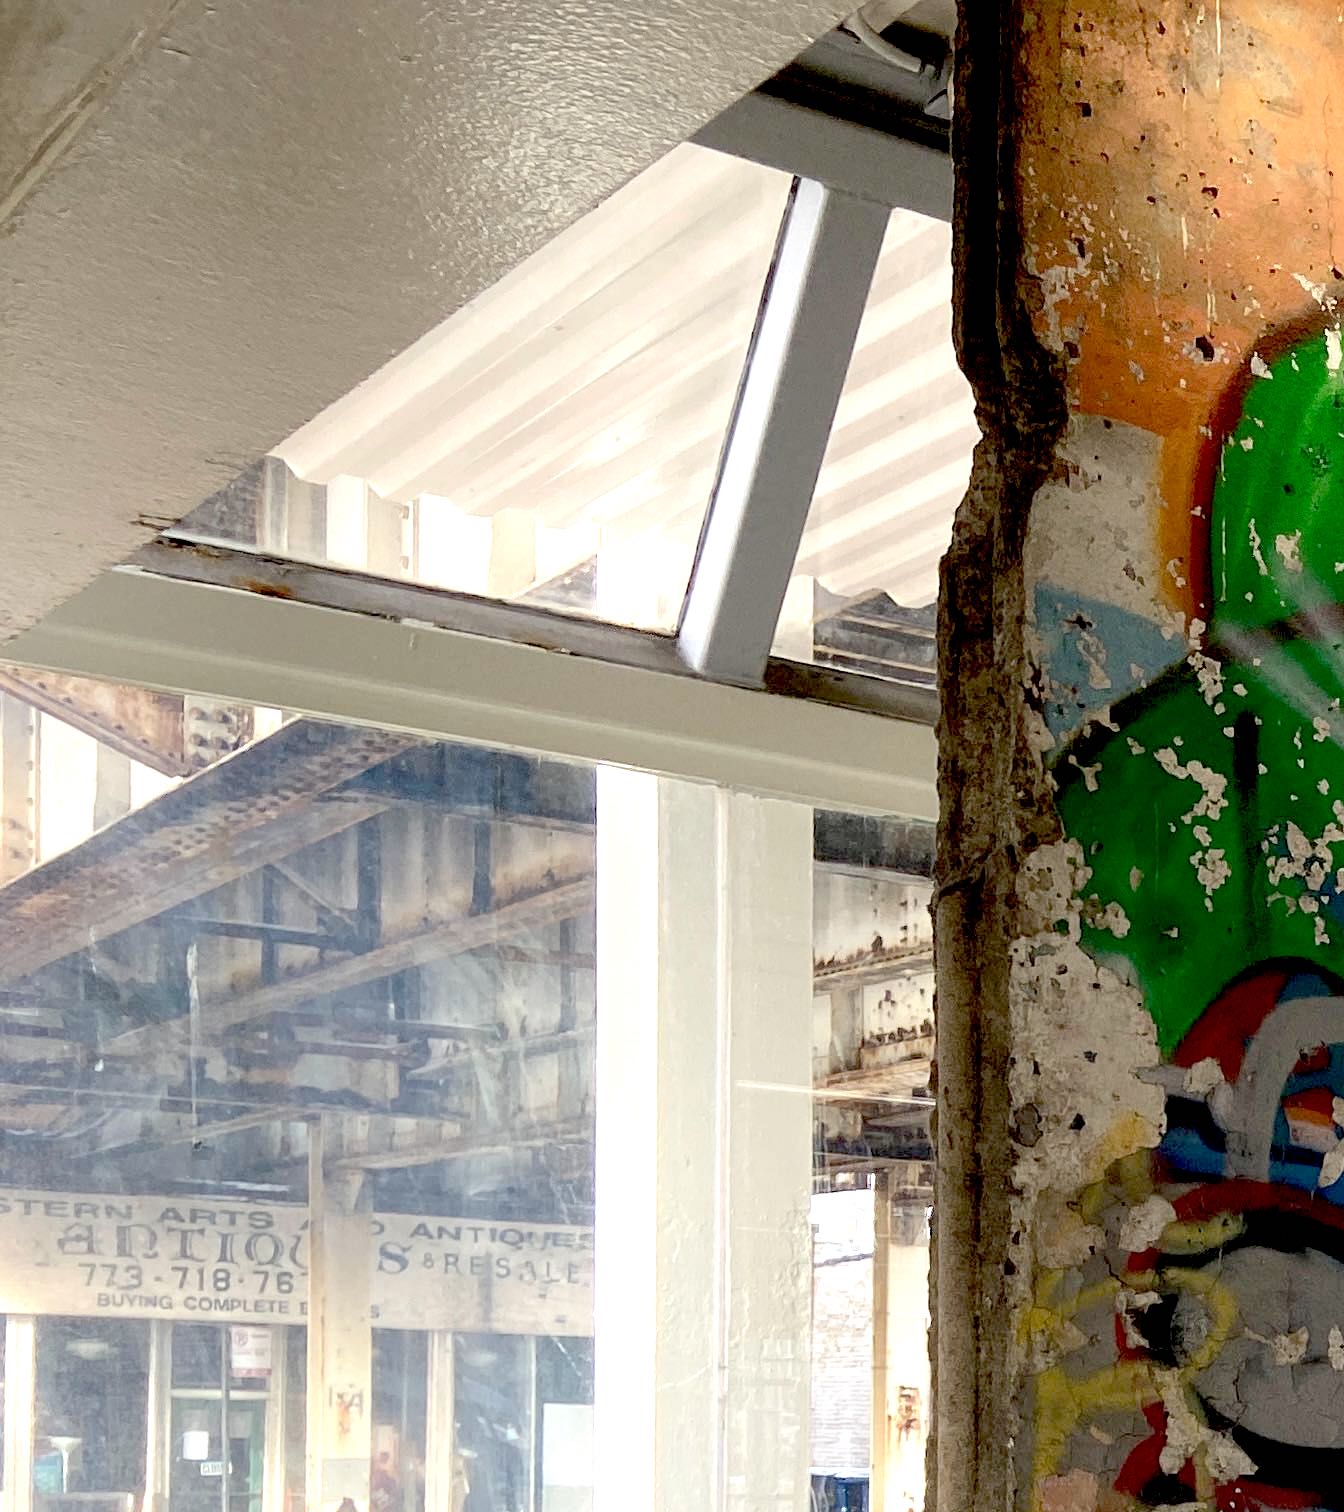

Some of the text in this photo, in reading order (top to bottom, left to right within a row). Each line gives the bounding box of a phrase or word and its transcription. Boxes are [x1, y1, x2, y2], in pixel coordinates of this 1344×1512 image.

[56, 1222, 412, 1275] ANTIQS
[157, 1206, 275, 1230] ARTS
[409, 1222, 593, 1251] ANTIQUES
[96, 1292, 173, 1310] BUYING
[184, 1296, 290, 1314] COMPLETE
